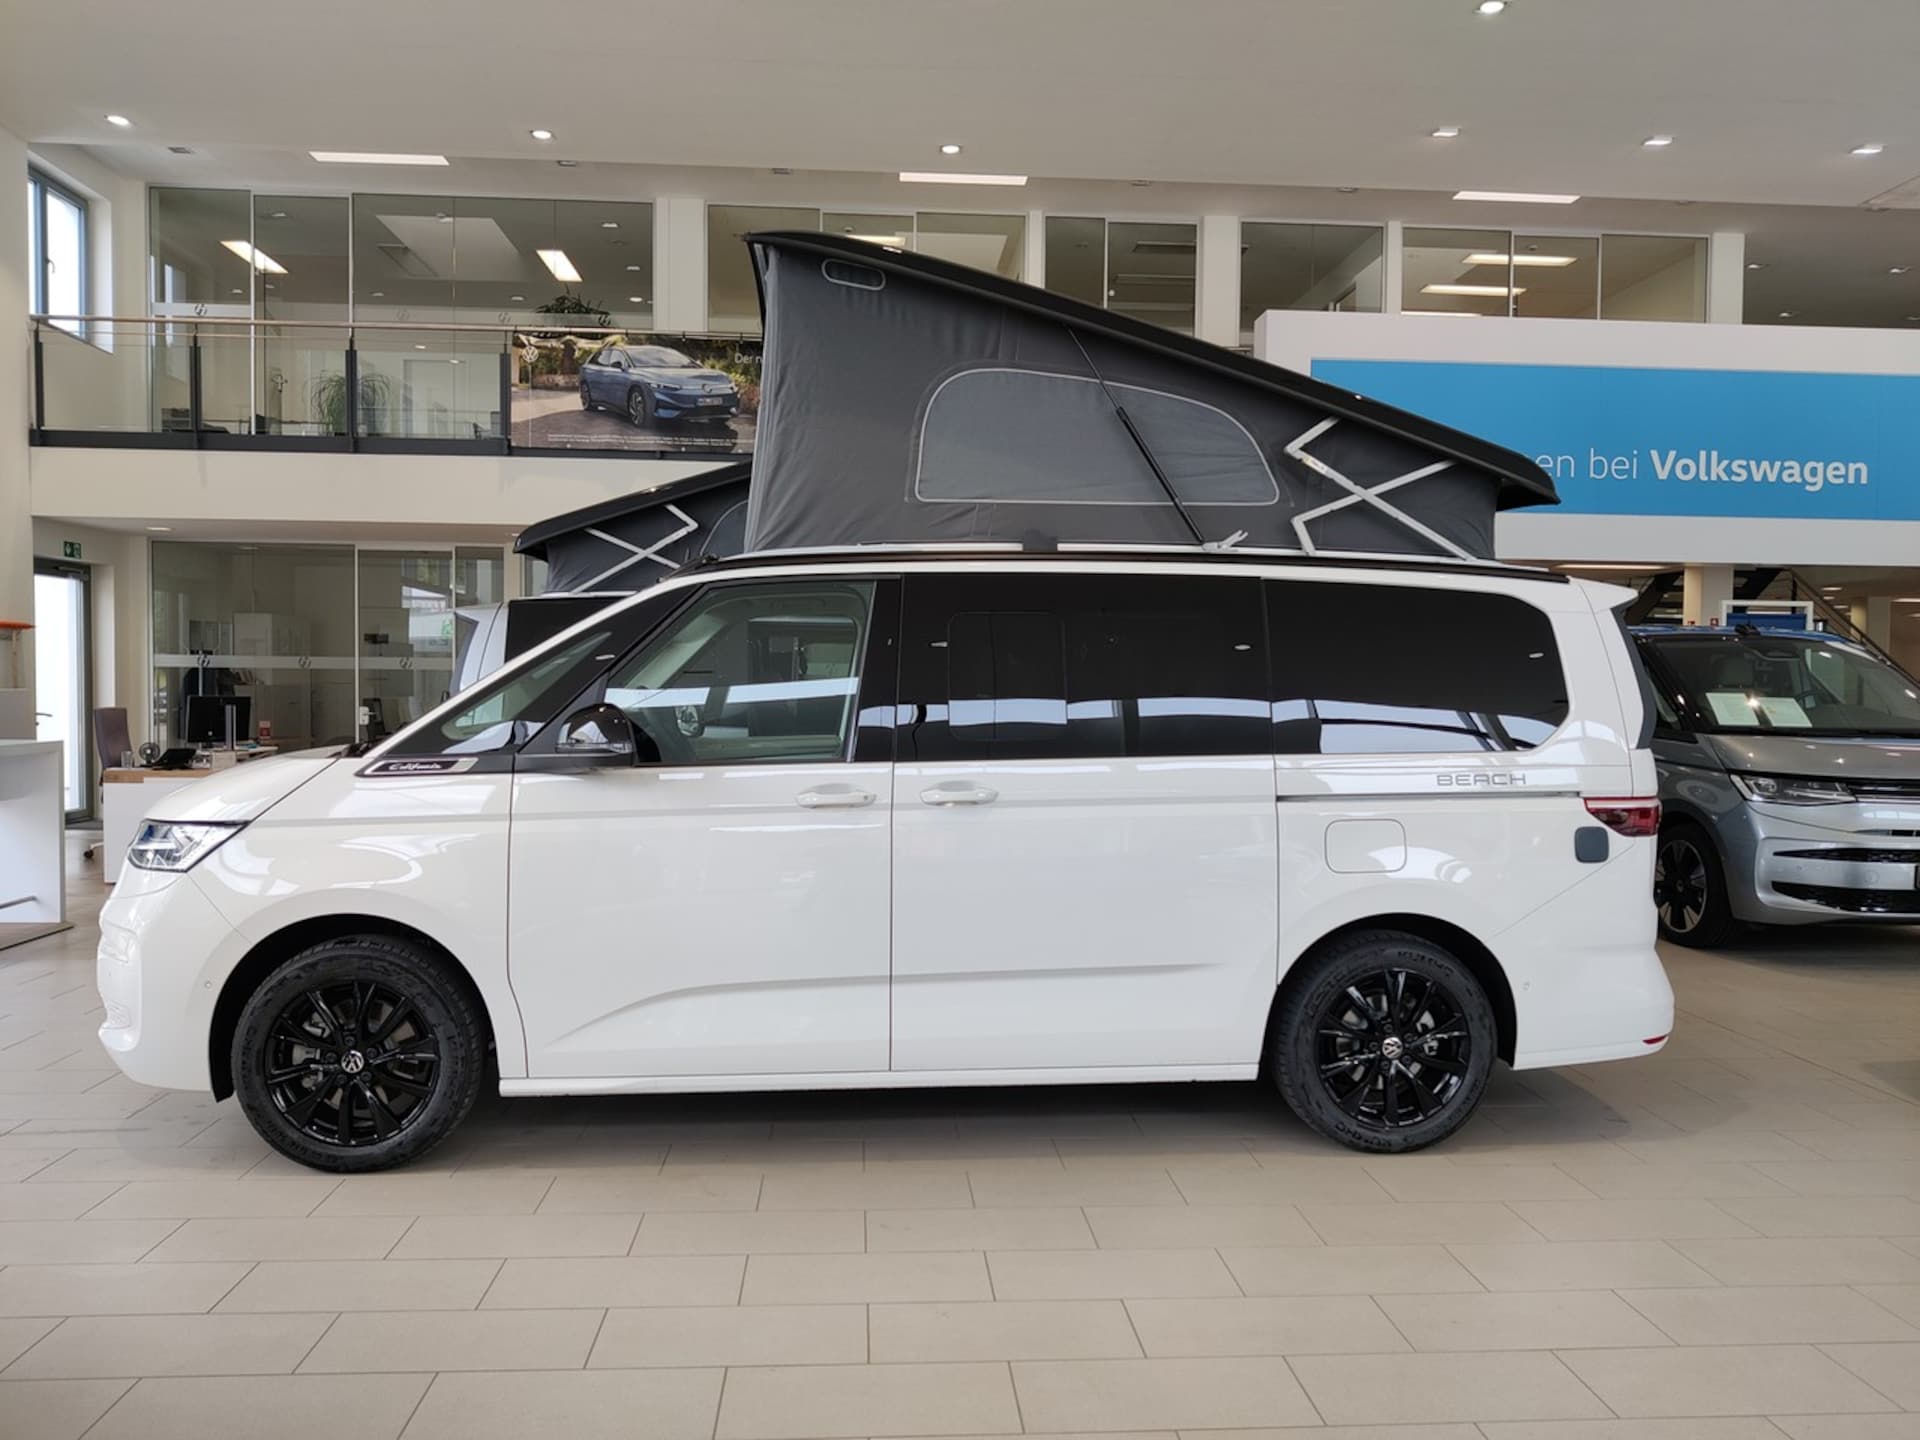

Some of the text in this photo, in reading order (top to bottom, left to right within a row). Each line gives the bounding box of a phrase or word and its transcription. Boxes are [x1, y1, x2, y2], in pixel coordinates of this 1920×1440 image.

[1589, 447, 1637, 479] bei
[1649, 449, 1868, 492] Volkswagen
[1436, 773, 1526, 786] BEACH
